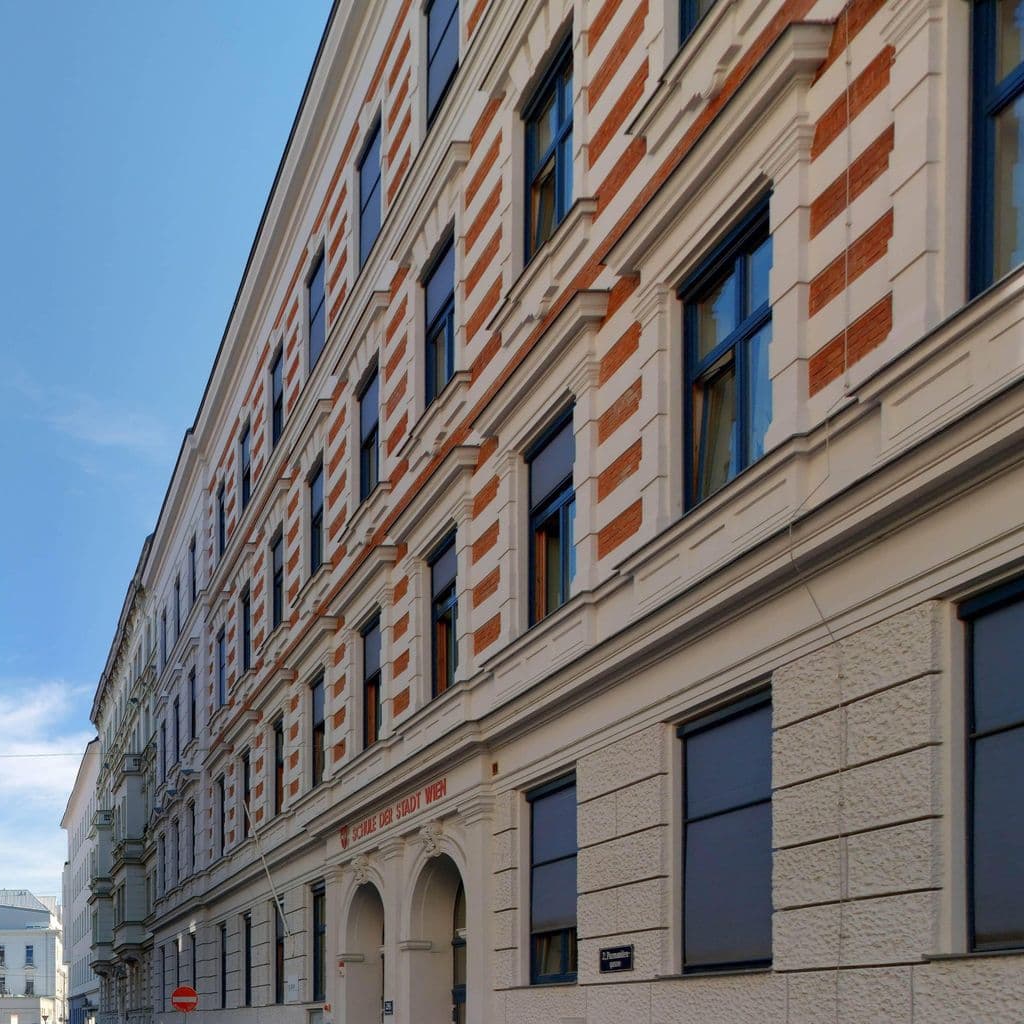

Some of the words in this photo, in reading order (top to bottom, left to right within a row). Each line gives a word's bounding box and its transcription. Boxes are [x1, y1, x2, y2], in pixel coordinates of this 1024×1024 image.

[352, 816, 376, 841] SCHULE
[379, 807, 393, 828] DER
[396, 792, 421, 819] STADT
[425, 778, 447, 805] WIEN
